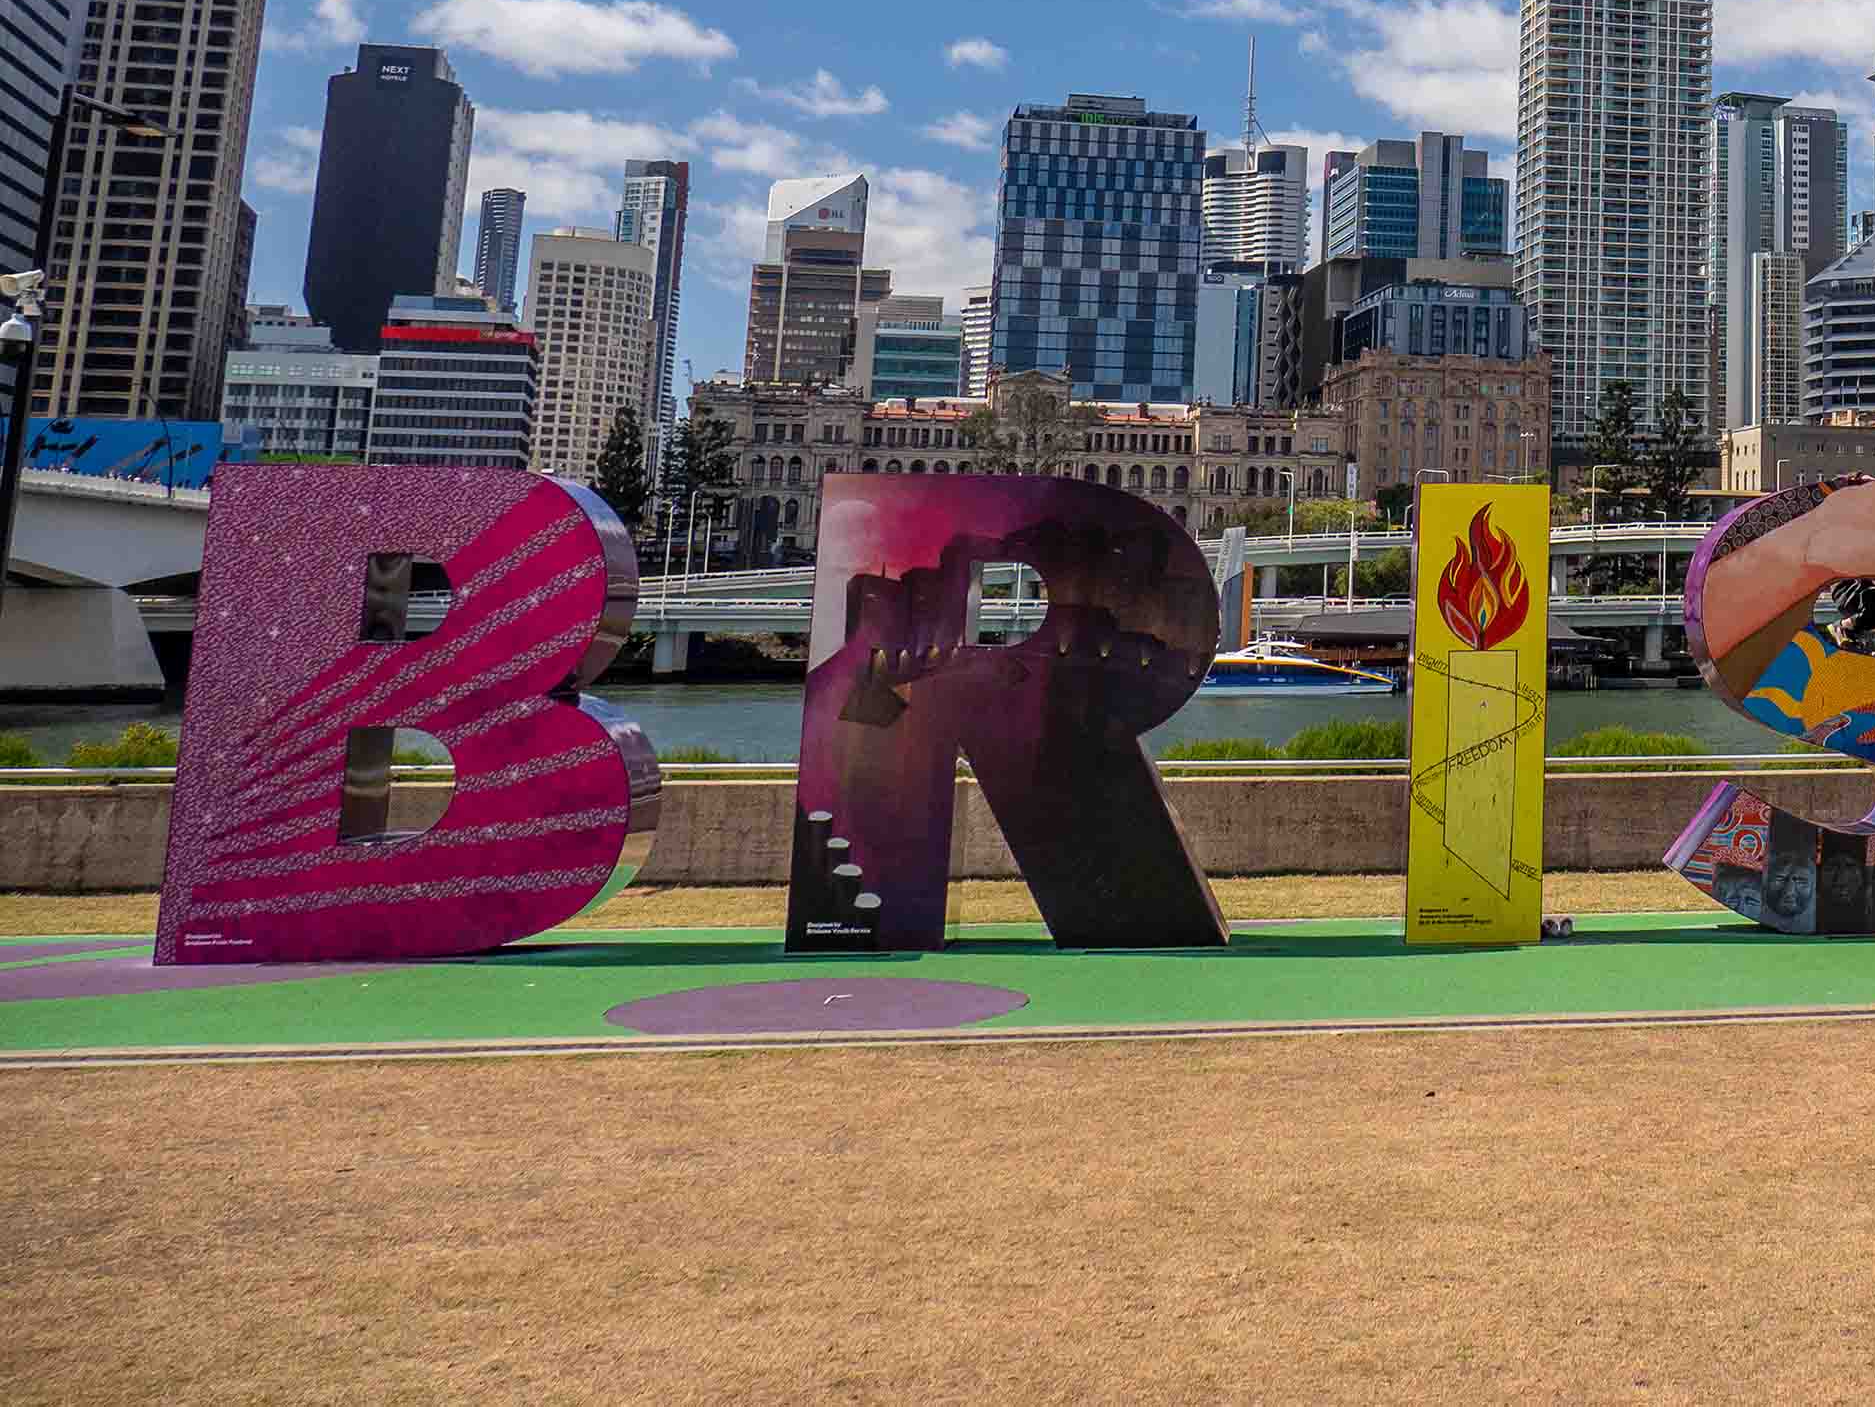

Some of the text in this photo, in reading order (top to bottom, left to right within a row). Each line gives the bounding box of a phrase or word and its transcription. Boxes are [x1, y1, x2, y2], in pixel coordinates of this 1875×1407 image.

[382, 65, 409, 74] NEXT
[1417, 651, 1449, 671] DIGNITY
[1447, 736, 1513, 775] FREEDOM
